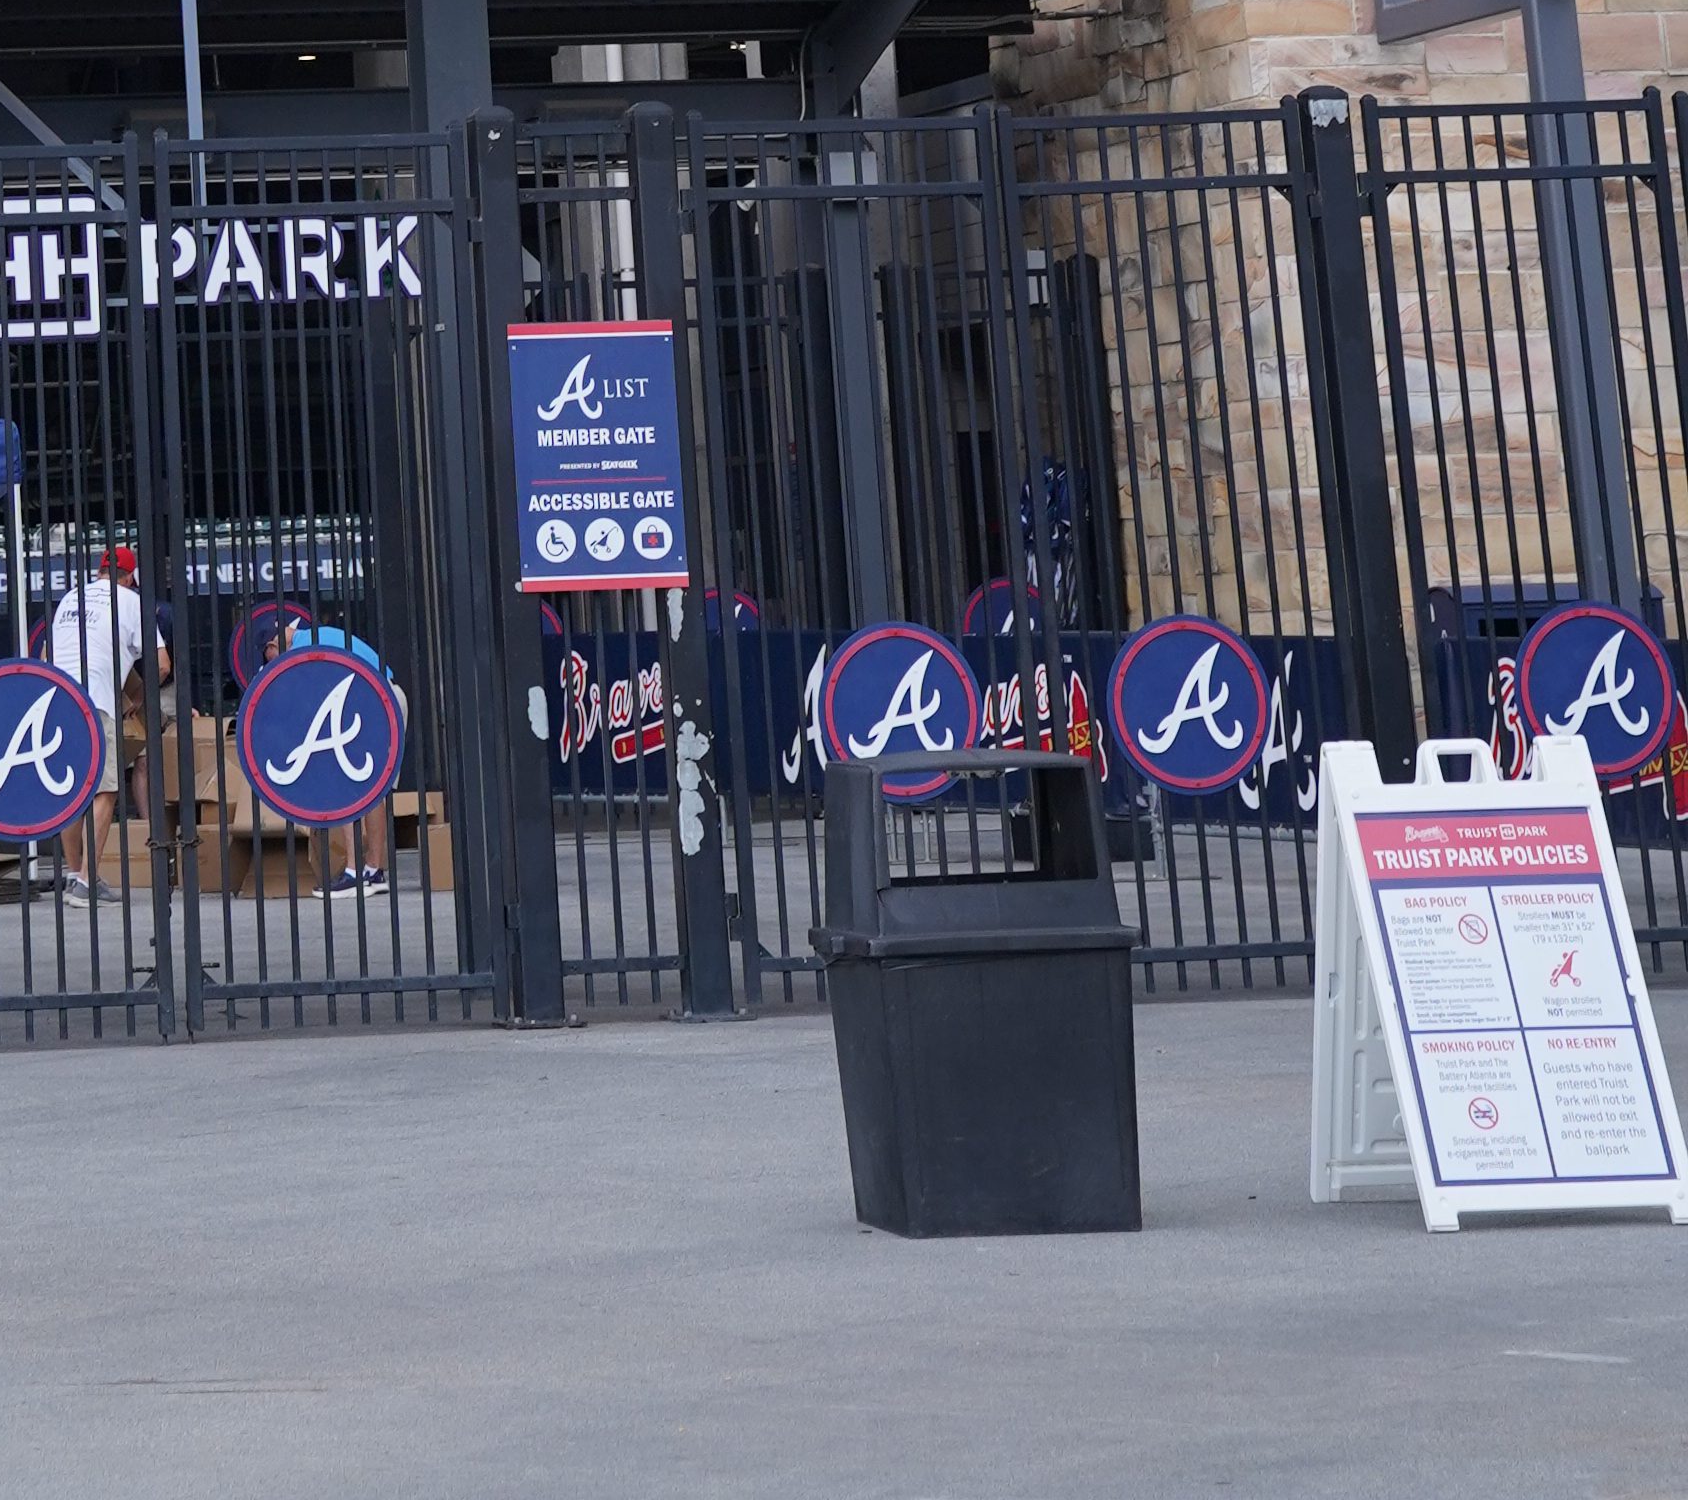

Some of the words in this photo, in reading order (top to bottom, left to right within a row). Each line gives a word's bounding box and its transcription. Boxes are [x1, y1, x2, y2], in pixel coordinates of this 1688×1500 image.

[139, 214, 423, 307] PARK
[537, 354, 603, 422] A
[603, 378, 649, 399] LIST
[537, 428, 611, 448] MEMBER
[614, 426, 656, 444] GATE
[601, 459, 638, 470] SEATGEEK
[528, 491, 629, 512] ACCESSIBLE
[632, 490, 675, 509] GATE
[1545, 628, 1650, 737] A
[848, 649, 955, 760] A
[1138, 642, 1244, 754] A
[559, 649, 666, 764] Brave
[266, 672, 375, 787] A
[1456, 827, 1498, 839] TRUIST
[1517, 826, 1548, 837] PARK
[1373, 849, 1442, 870] TRUIST
[1446, 846, 1499, 868] PARK
[1500, 844, 1589, 866] POLICIES
[1404, 897, 1427, 909] BAG
[1430, 896, 1467, 908] POLICY
[1501, 893, 1556, 906] STROLLER
[1557, 892, 1594, 904] POLICY
[1425, 914, 1442, 924] NOT
[1551, 911, 1575, 921] MUST
[1547, 1008, 1563, 1018] NOT
[1422, 1041, 1474, 1054] SMOKING
[1477, 1040, 1515, 1052] POLICY
[1547, 1038, 1564, 1050] NO
[1566, 1037, 1617, 1049] RE-ENTRY
[1543, 1062, 1582, 1074] Guests
[1583, 1061, 1606, 1073] who
[1607, 1061, 1633, 1072] have
[1556, 1078, 1597, 1091] entered
[1599, 1077, 1629, 1089] Truist
[1555, 1095, 1580, 1107] Park
[1582, 1094, 1600, 1106] will
[1602, 1094, 1620, 1105] not
[1622, 1093, 1636, 1105] be
[1562, 1111, 1603, 1123] allowed
[1605, 1111, 1617, 1122] to
[1619, 1110, 1639, 1121] exit
[1561, 1127, 1581, 1140] and
[1584, 1126, 1627, 1139] re-enter
[1629, 1125, 1647, 1138] the
[1585, 1143, 1631, 1157] ballpark
